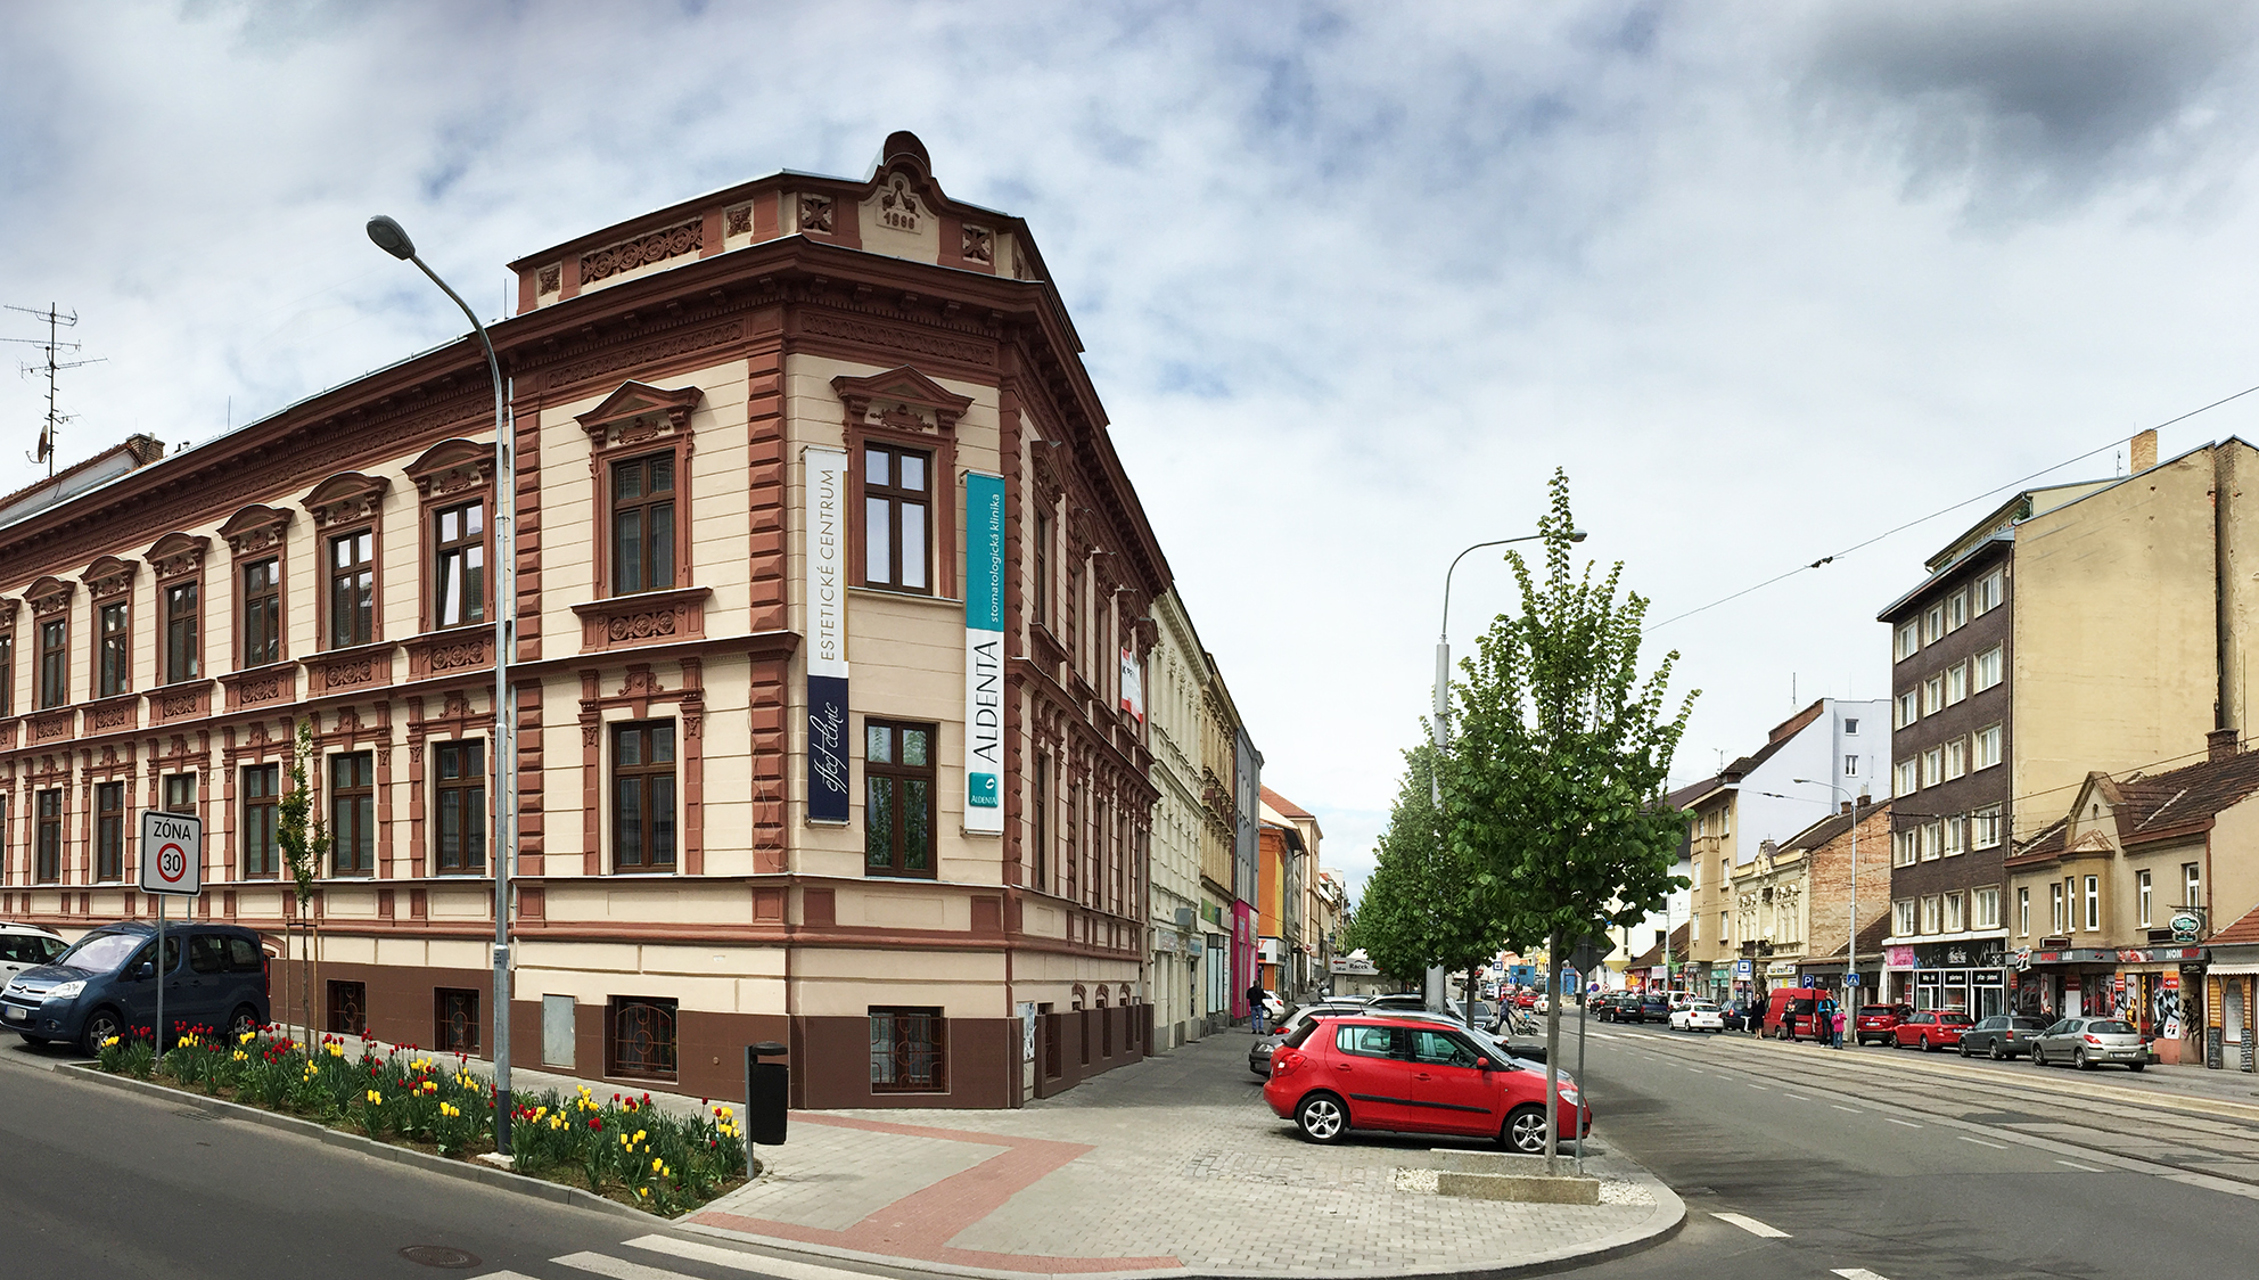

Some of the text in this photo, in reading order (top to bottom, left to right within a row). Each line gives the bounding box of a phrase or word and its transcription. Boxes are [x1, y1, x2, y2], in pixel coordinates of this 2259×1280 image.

[816, 469, 835, 661] ESTETICKÉ CENTRUM
[989, 493, 1001, 623] stomatologická klinika
[973, 641, 998, 764] ALDENTA
[809, 701, 847, 795] effect clinic
[970, 795, 997, 805] ALDENTA
[154, 819, 192, 841] ZÓNA
[163, 854, 181, 872] 30
[1804, 976, 1812, 985] P
